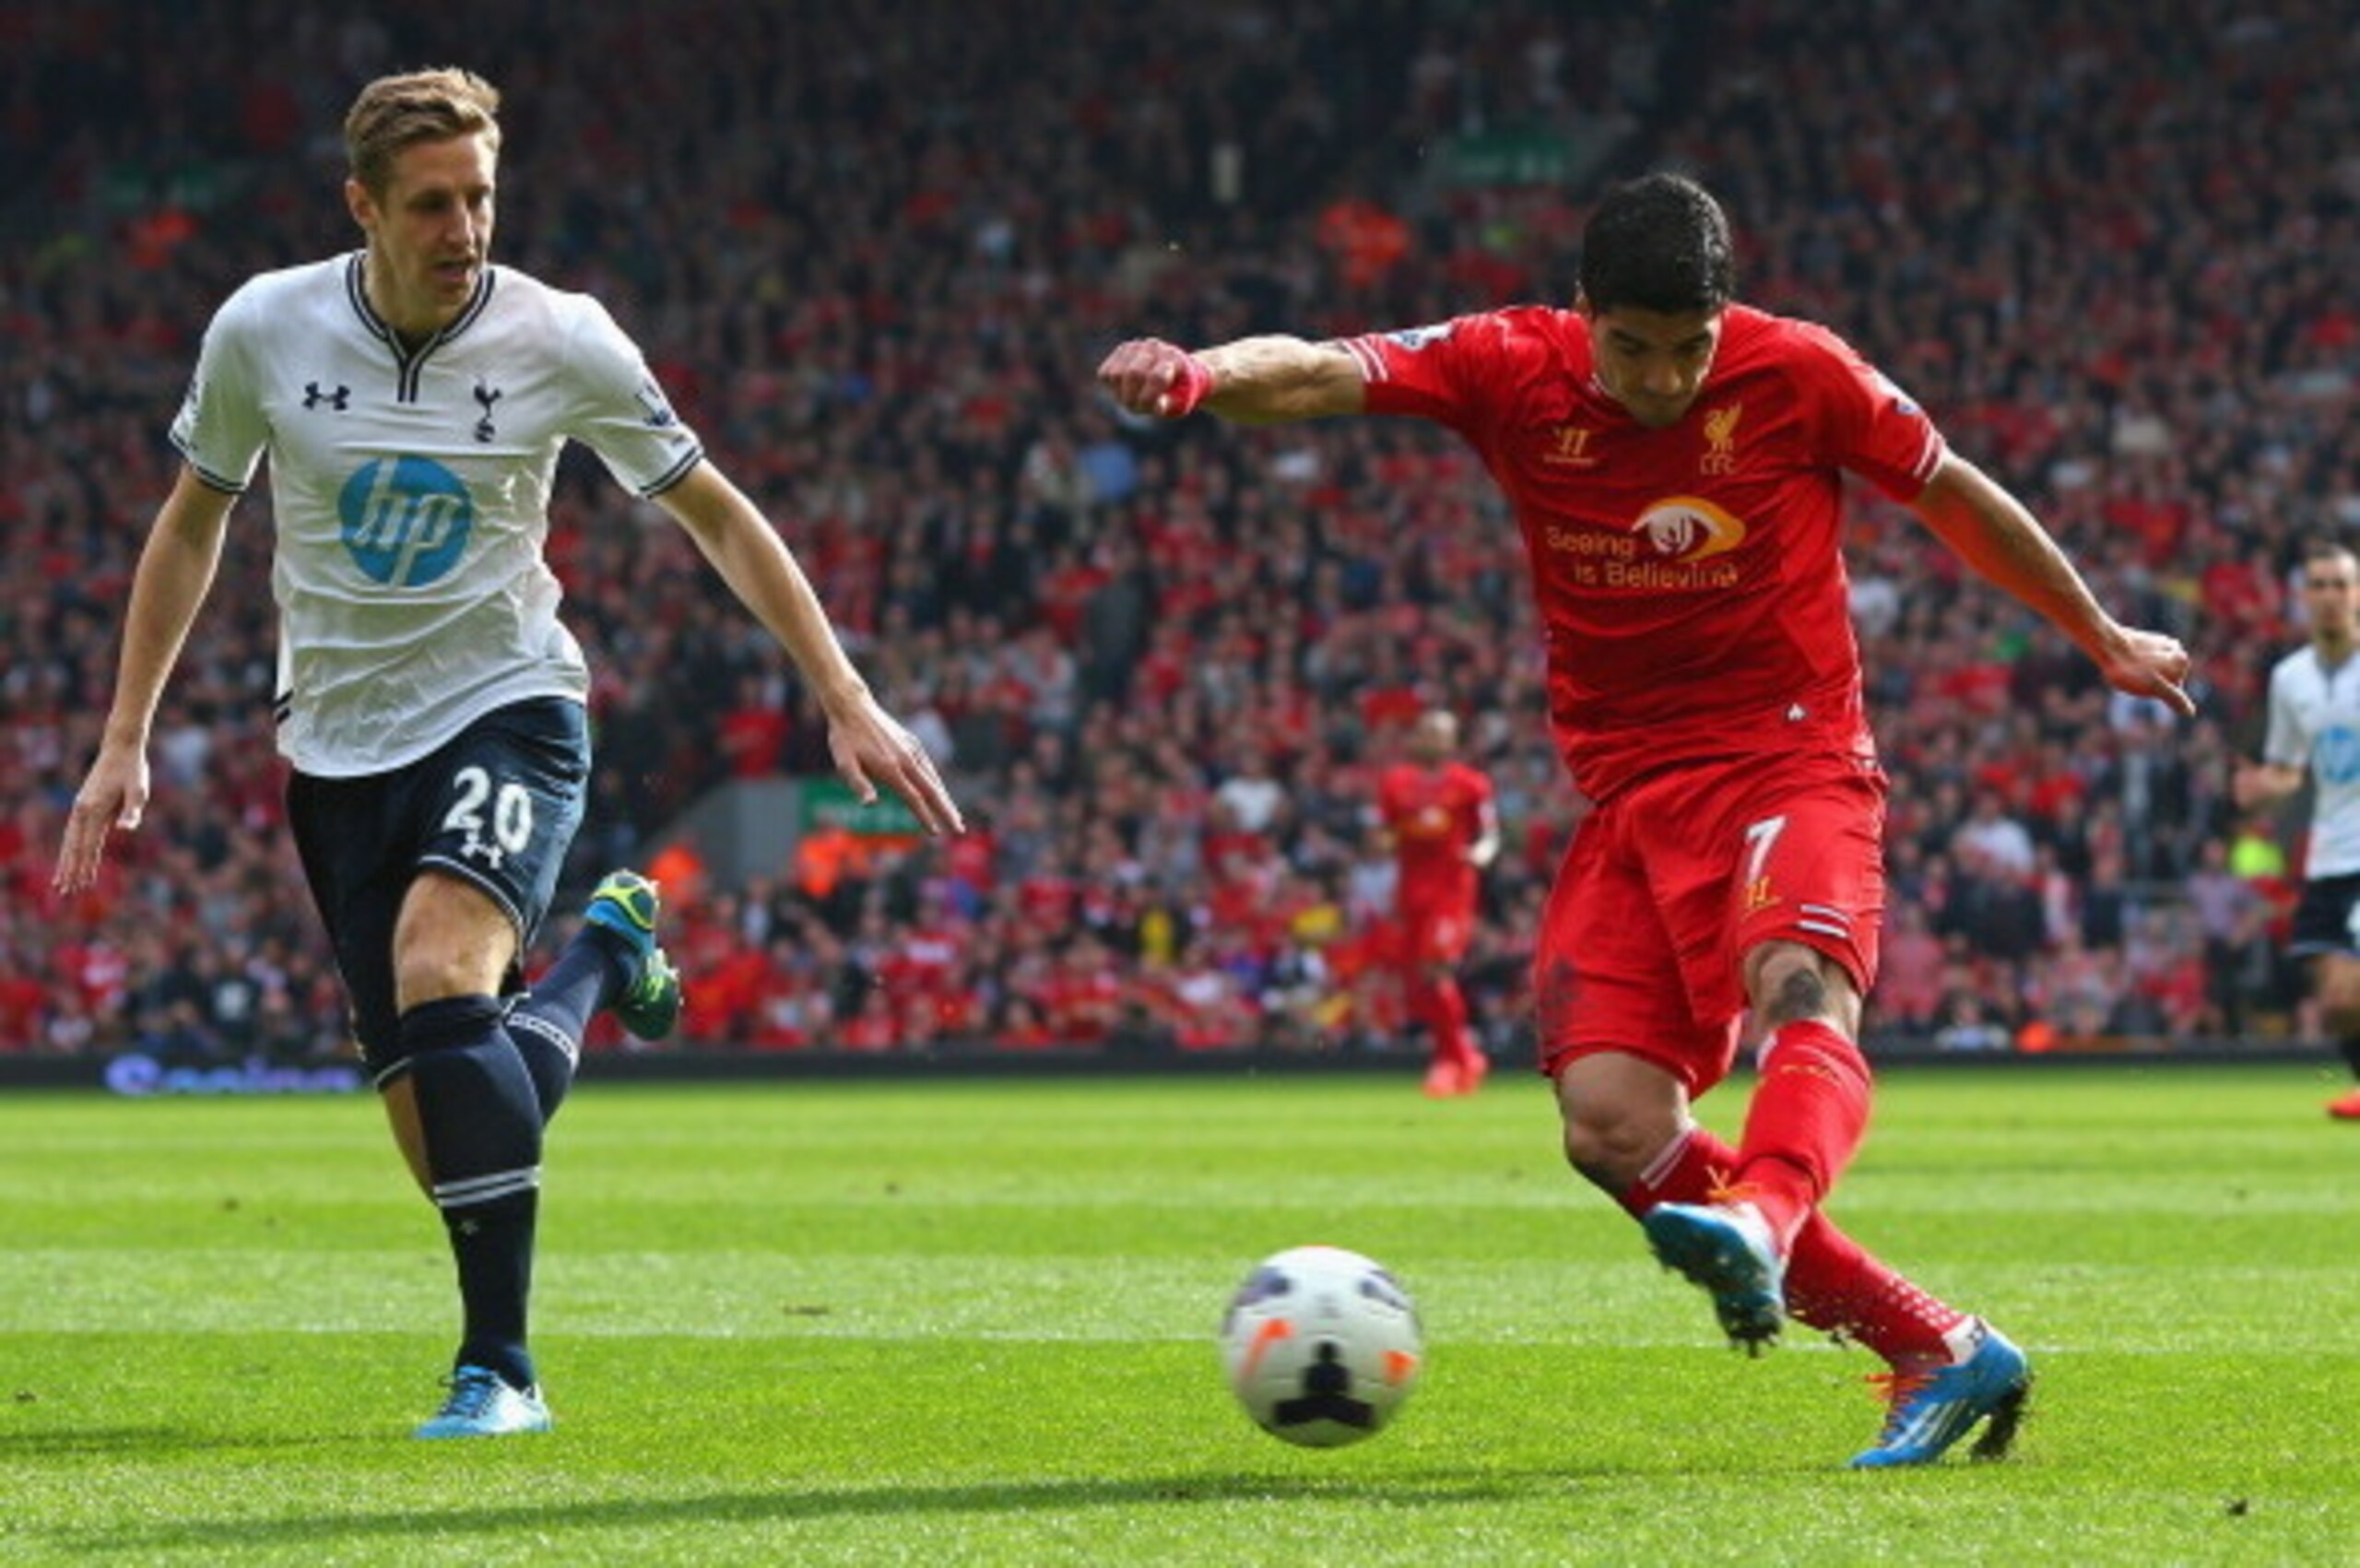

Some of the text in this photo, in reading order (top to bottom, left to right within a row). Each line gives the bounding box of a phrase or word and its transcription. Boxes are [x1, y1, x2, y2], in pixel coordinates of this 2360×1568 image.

[354, 457, 462, 584] hp
[1546, 526, 1634, 561] Seeing
[1575, 564, 1597, 584] is
[442, 765, 532, 854] 20
[1744, 816, 1787, 885] 7
